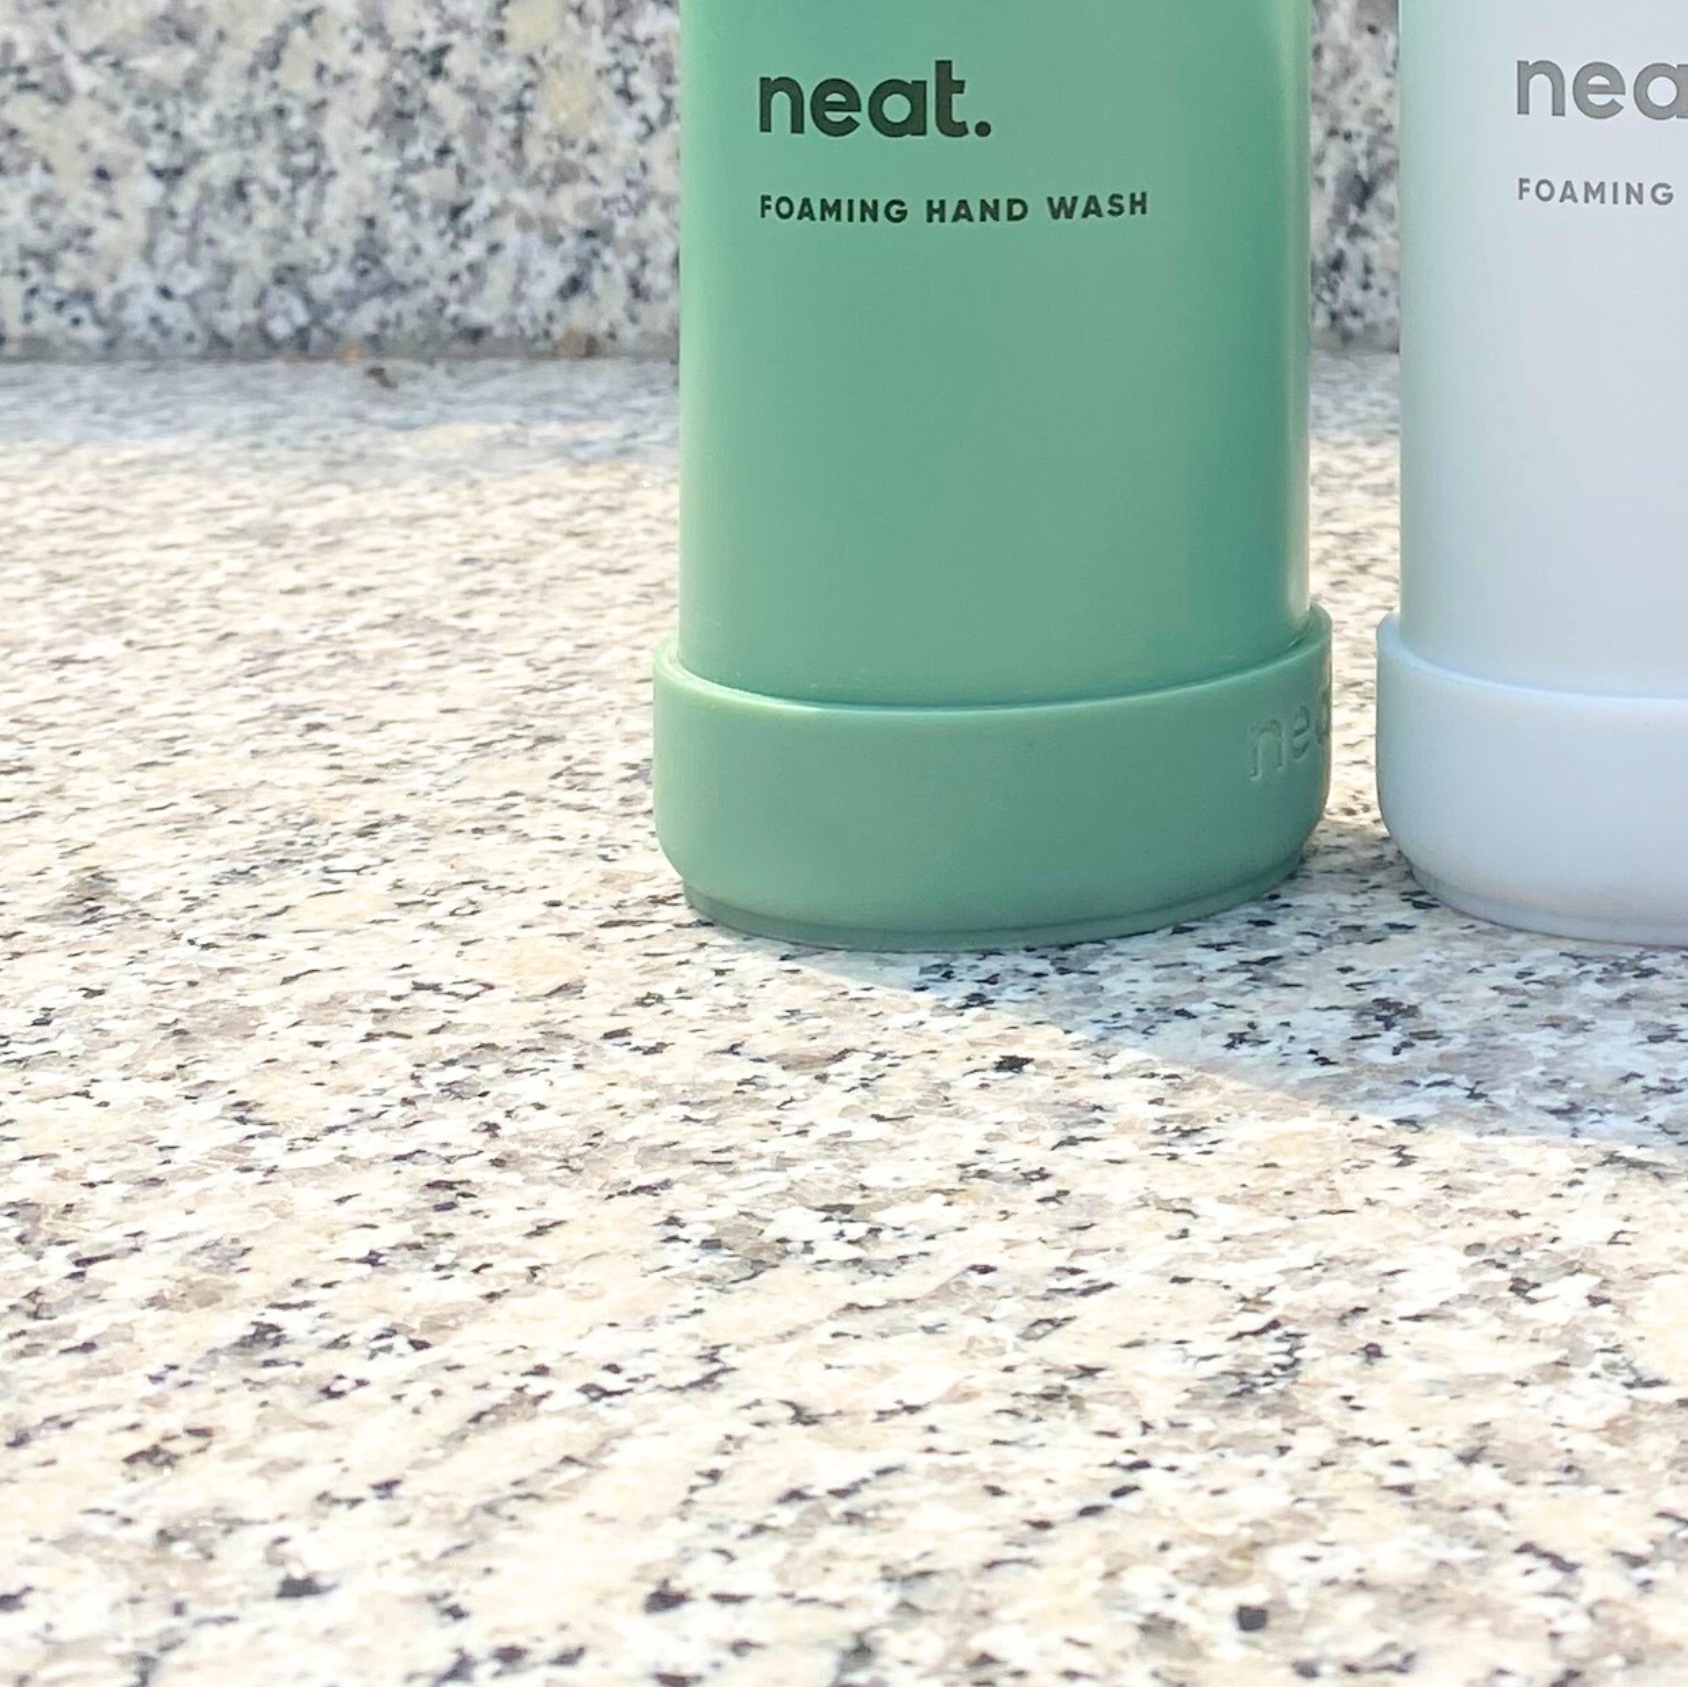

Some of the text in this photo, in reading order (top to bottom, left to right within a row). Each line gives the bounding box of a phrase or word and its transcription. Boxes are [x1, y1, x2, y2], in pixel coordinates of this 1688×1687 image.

[759, 59, 992, 138] neat.
[760, 191, 1148, 224] FOAMING HAND WASH
[1518, 177, 1674, 206] FOAMING
